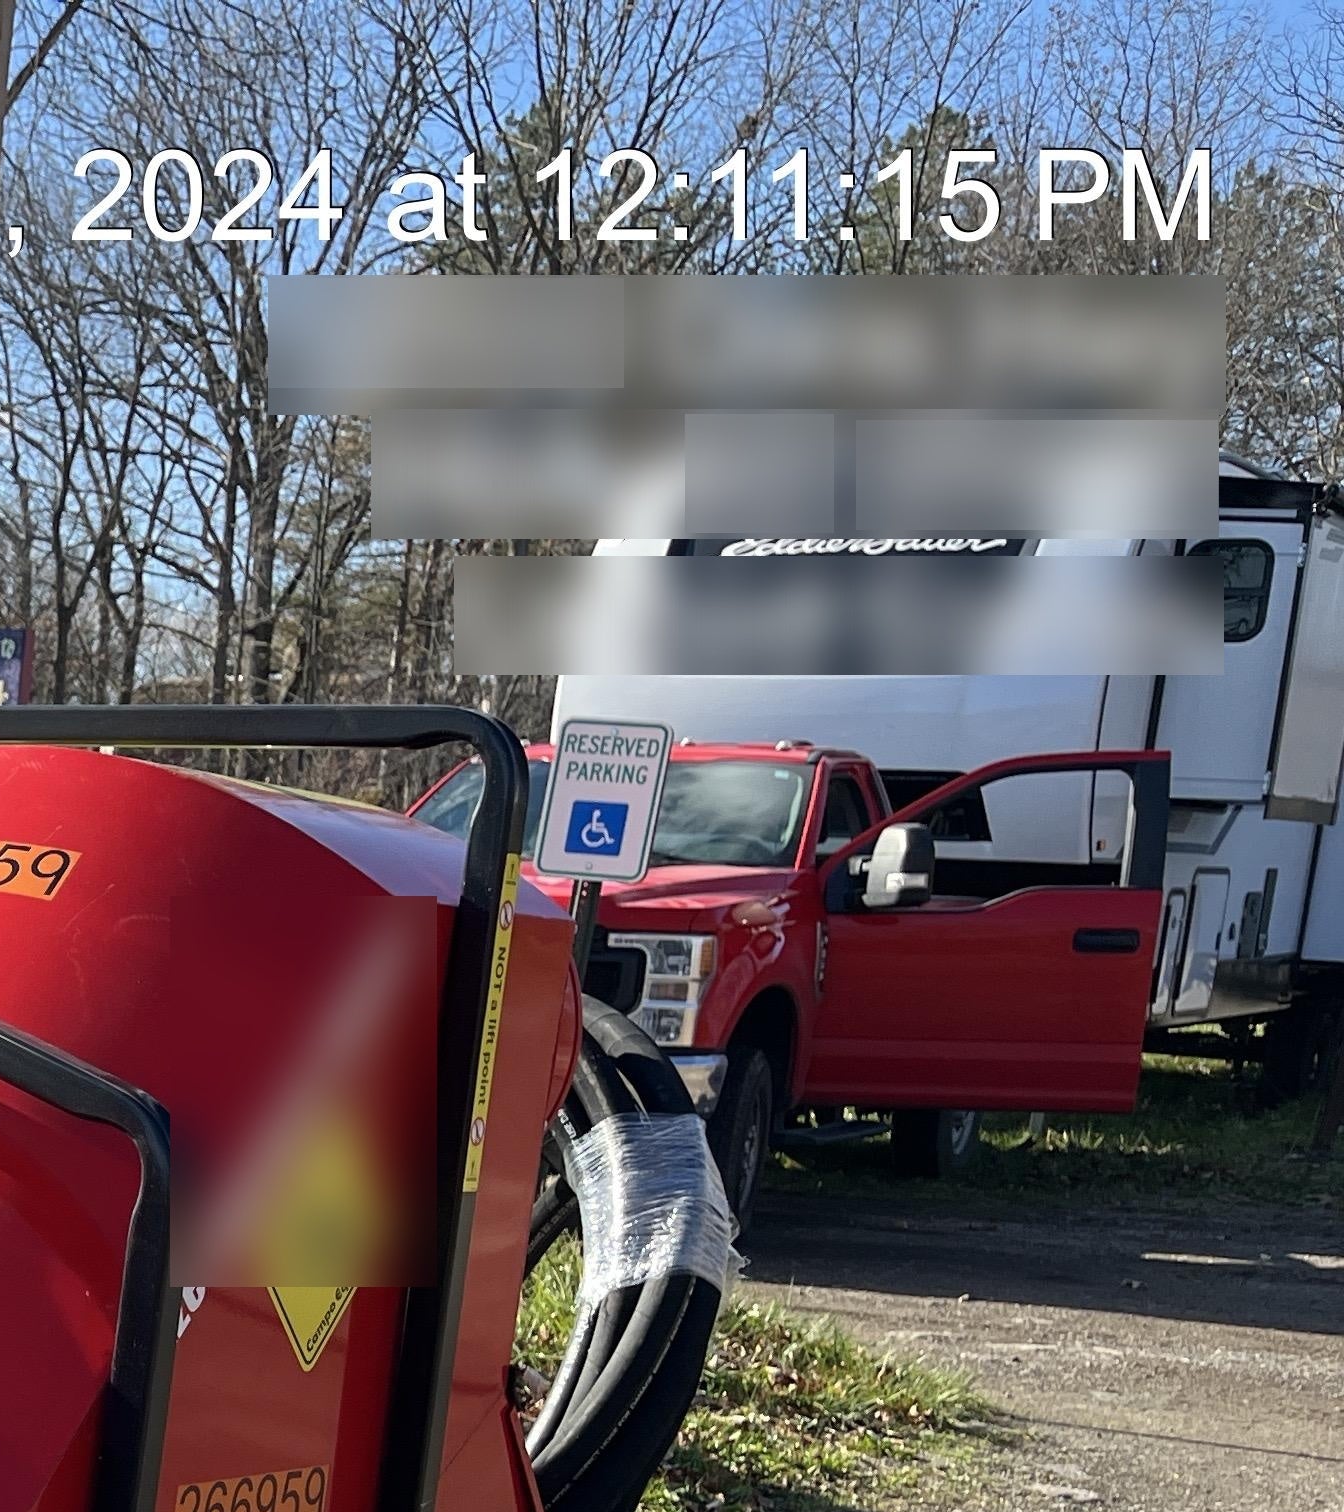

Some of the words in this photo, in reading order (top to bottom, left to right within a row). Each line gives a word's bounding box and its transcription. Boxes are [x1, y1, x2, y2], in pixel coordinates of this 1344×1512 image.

[564, 733, 660, 758] RESERVED
[565, 760, 649, 785] PARKING
[494, 946, 507, 993] NOT
[490, 1000, 498, 1011] a
[486, 1019, 497, 1045] lift
[477, 1051, 491, 1106] point
[306, 1302, 336, 1352] Campo
